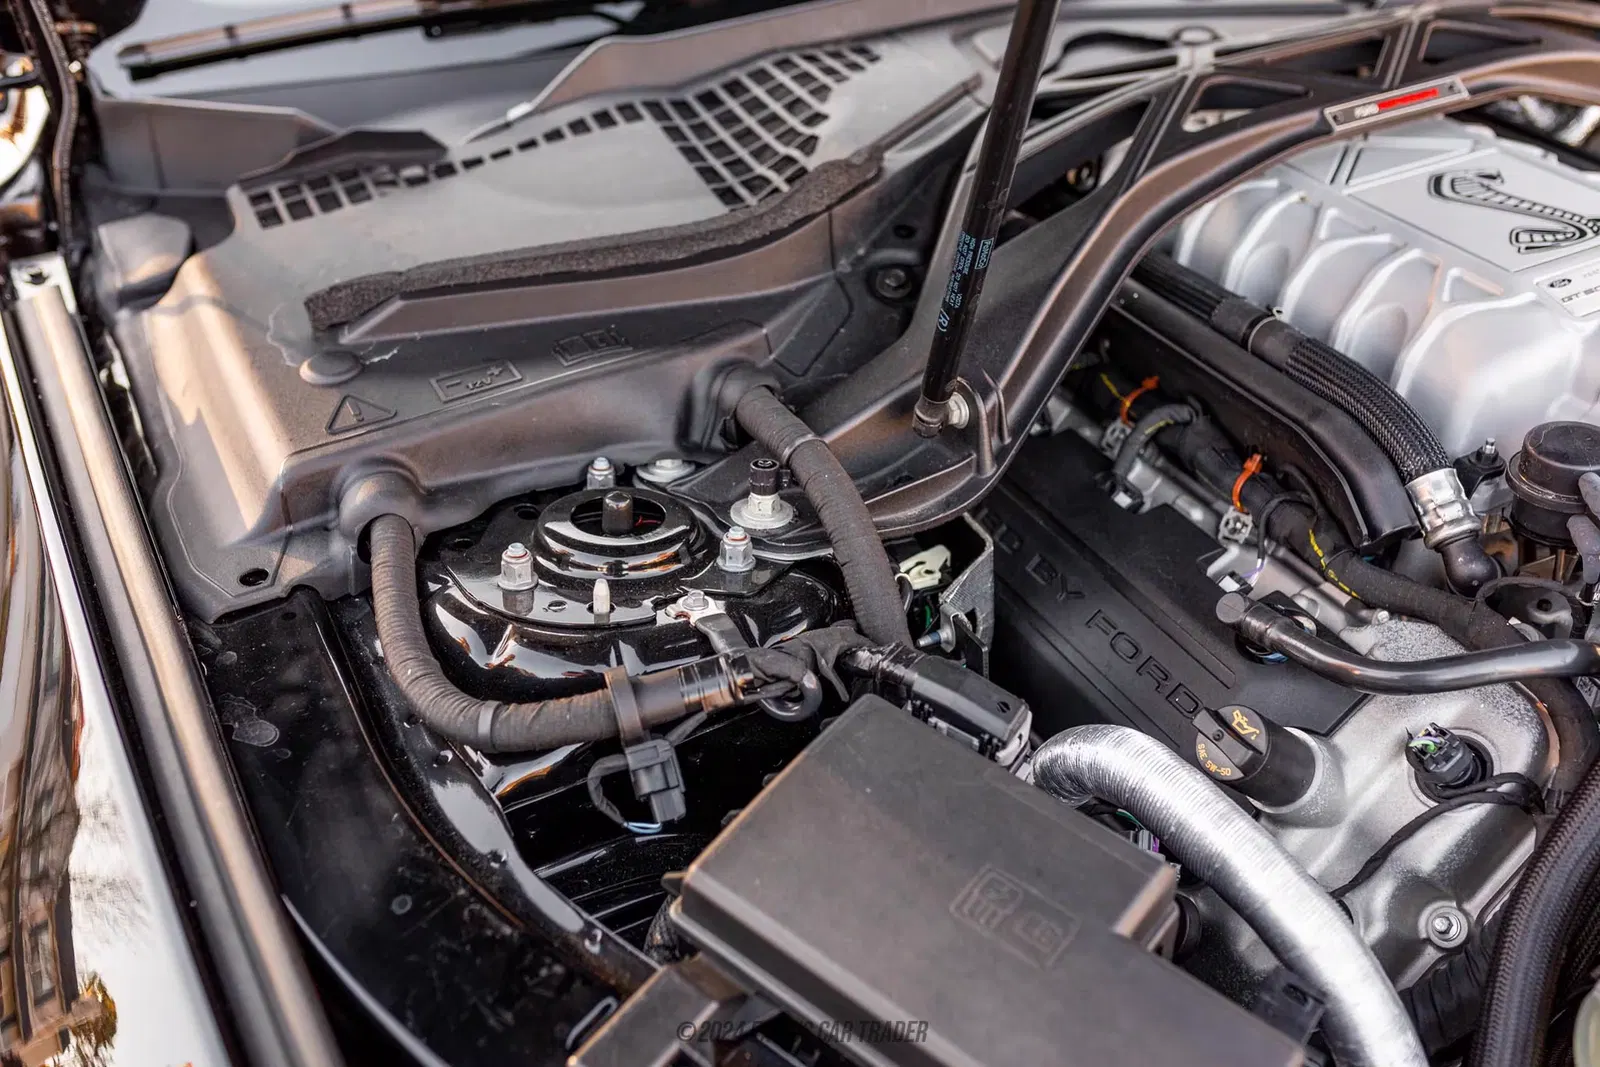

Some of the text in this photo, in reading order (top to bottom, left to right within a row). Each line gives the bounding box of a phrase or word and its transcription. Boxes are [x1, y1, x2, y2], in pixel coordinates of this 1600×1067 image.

[1026, 553, 1086, 601] BY
[1085, 608, 1203, 719] FORD
[1198, 743, 1232, 776] SAE 5W-50
